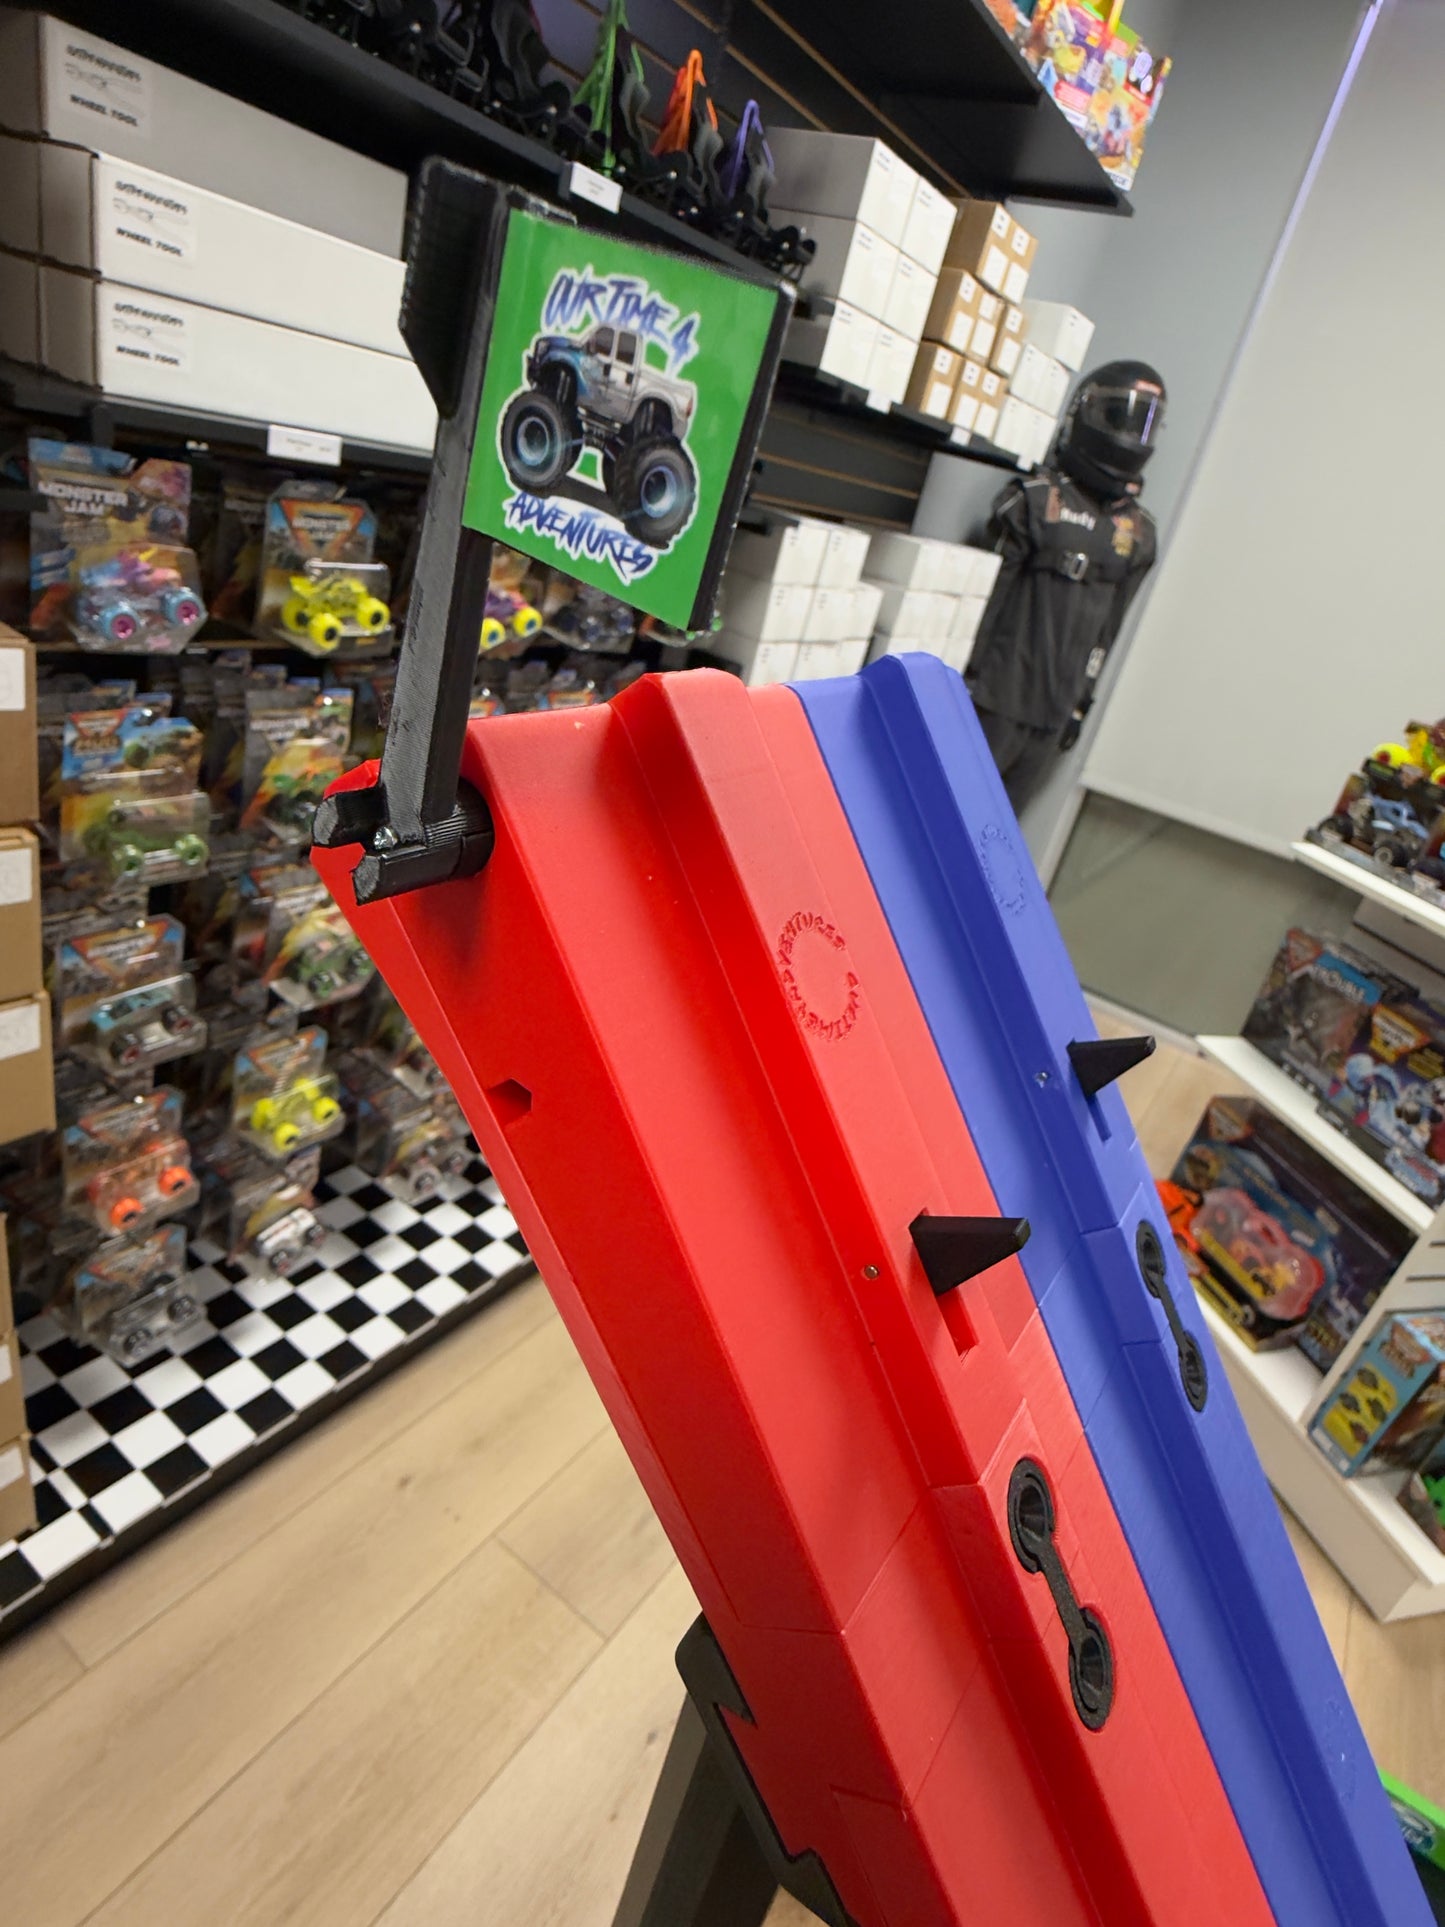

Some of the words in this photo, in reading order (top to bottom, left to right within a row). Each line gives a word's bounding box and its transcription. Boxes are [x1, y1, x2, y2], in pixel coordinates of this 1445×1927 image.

[155, 240, 183, 258] TOOL
[545, 274, 606, 328] OUR
[604, 279, 670, 345] TIME
[671, 318, 696, 370] 4
[38, 480, 129, 507] MONSTER
[64, 499, 105, 517] JAM
[508, 490, 654, 580] ADVENTURES
